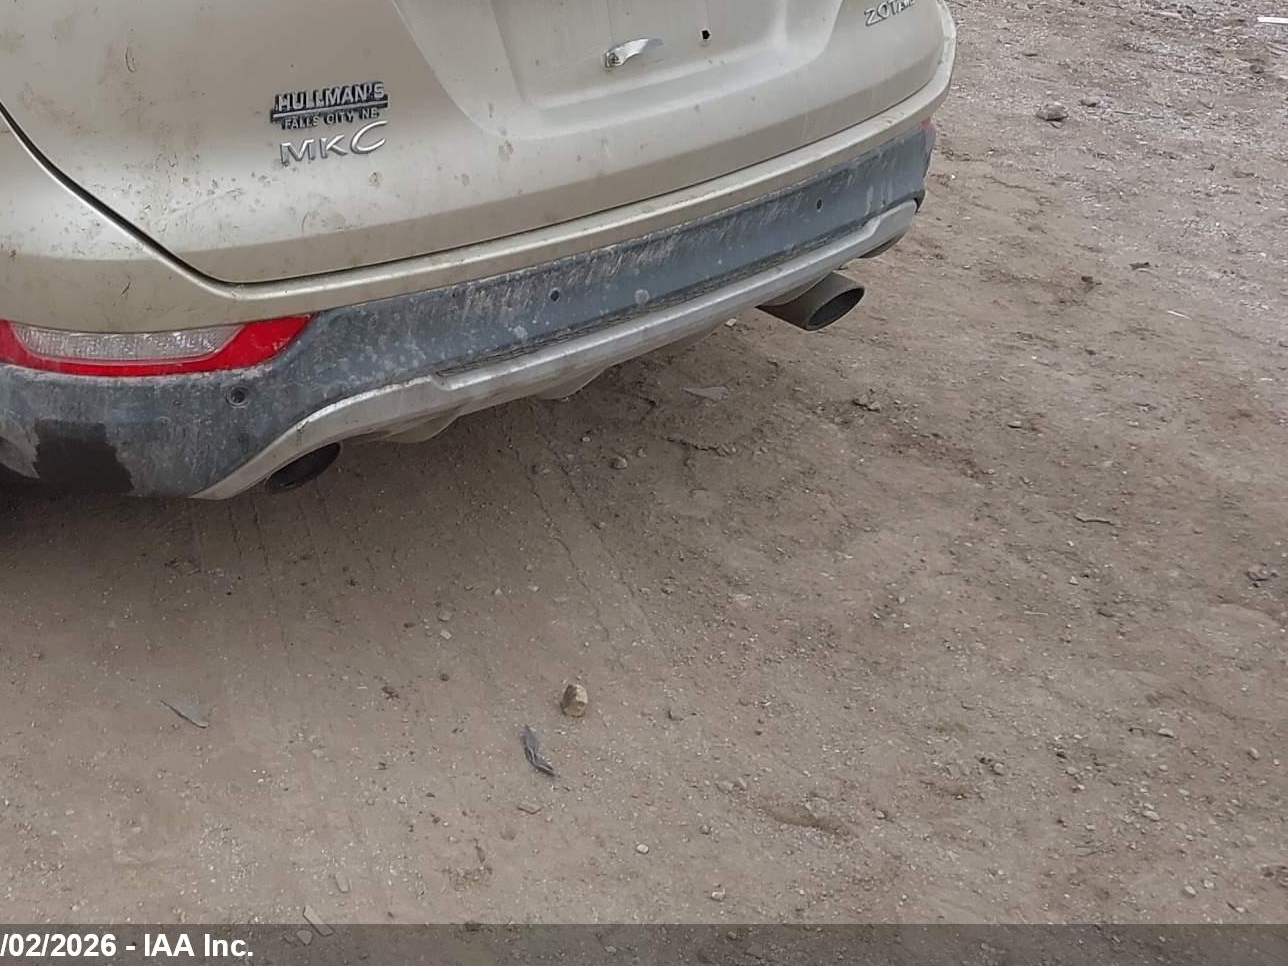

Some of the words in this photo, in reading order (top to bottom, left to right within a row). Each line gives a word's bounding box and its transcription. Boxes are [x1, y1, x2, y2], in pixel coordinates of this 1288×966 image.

[275, 81, 386, 112] HULLMAN'S
[280, 114, 321, 131] FALLS
[323, 110, 355, 126] CITY
[279, 119, 389, 166] MKC
